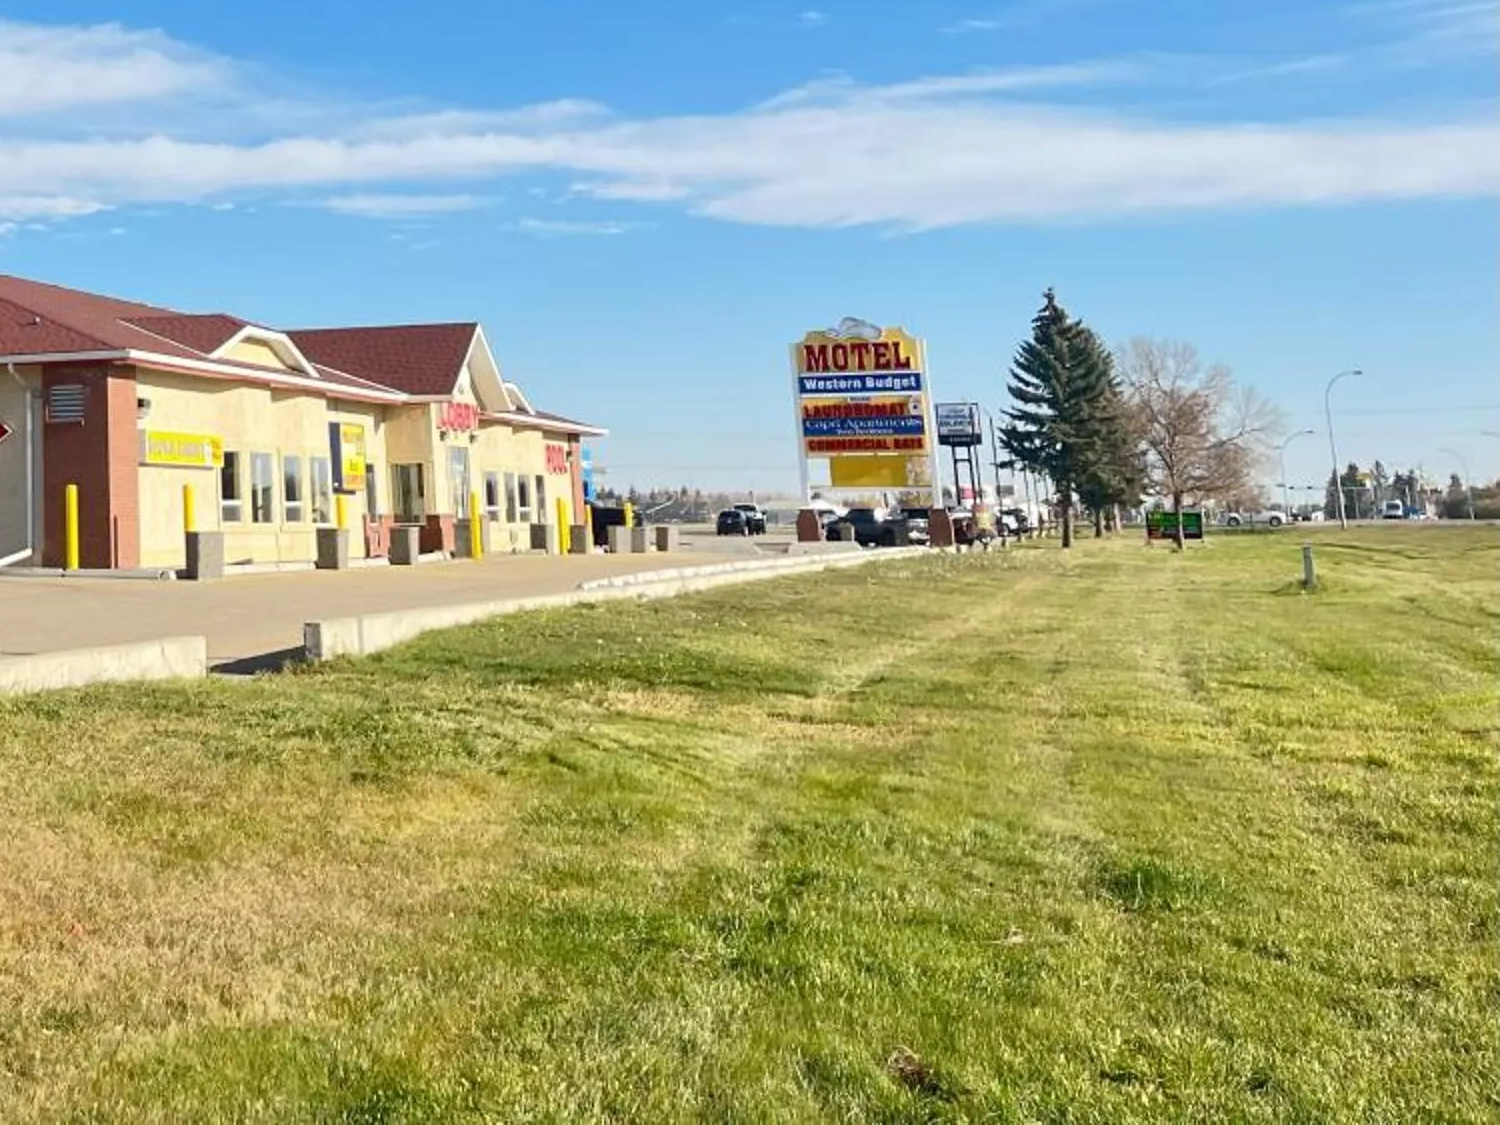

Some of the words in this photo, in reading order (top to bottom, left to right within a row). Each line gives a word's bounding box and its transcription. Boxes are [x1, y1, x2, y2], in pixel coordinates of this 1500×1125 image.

[804, 342, 910, 372] MOTEL
[804, 378, 861, 390] Western
[865, 376, 917, 389] Budget
